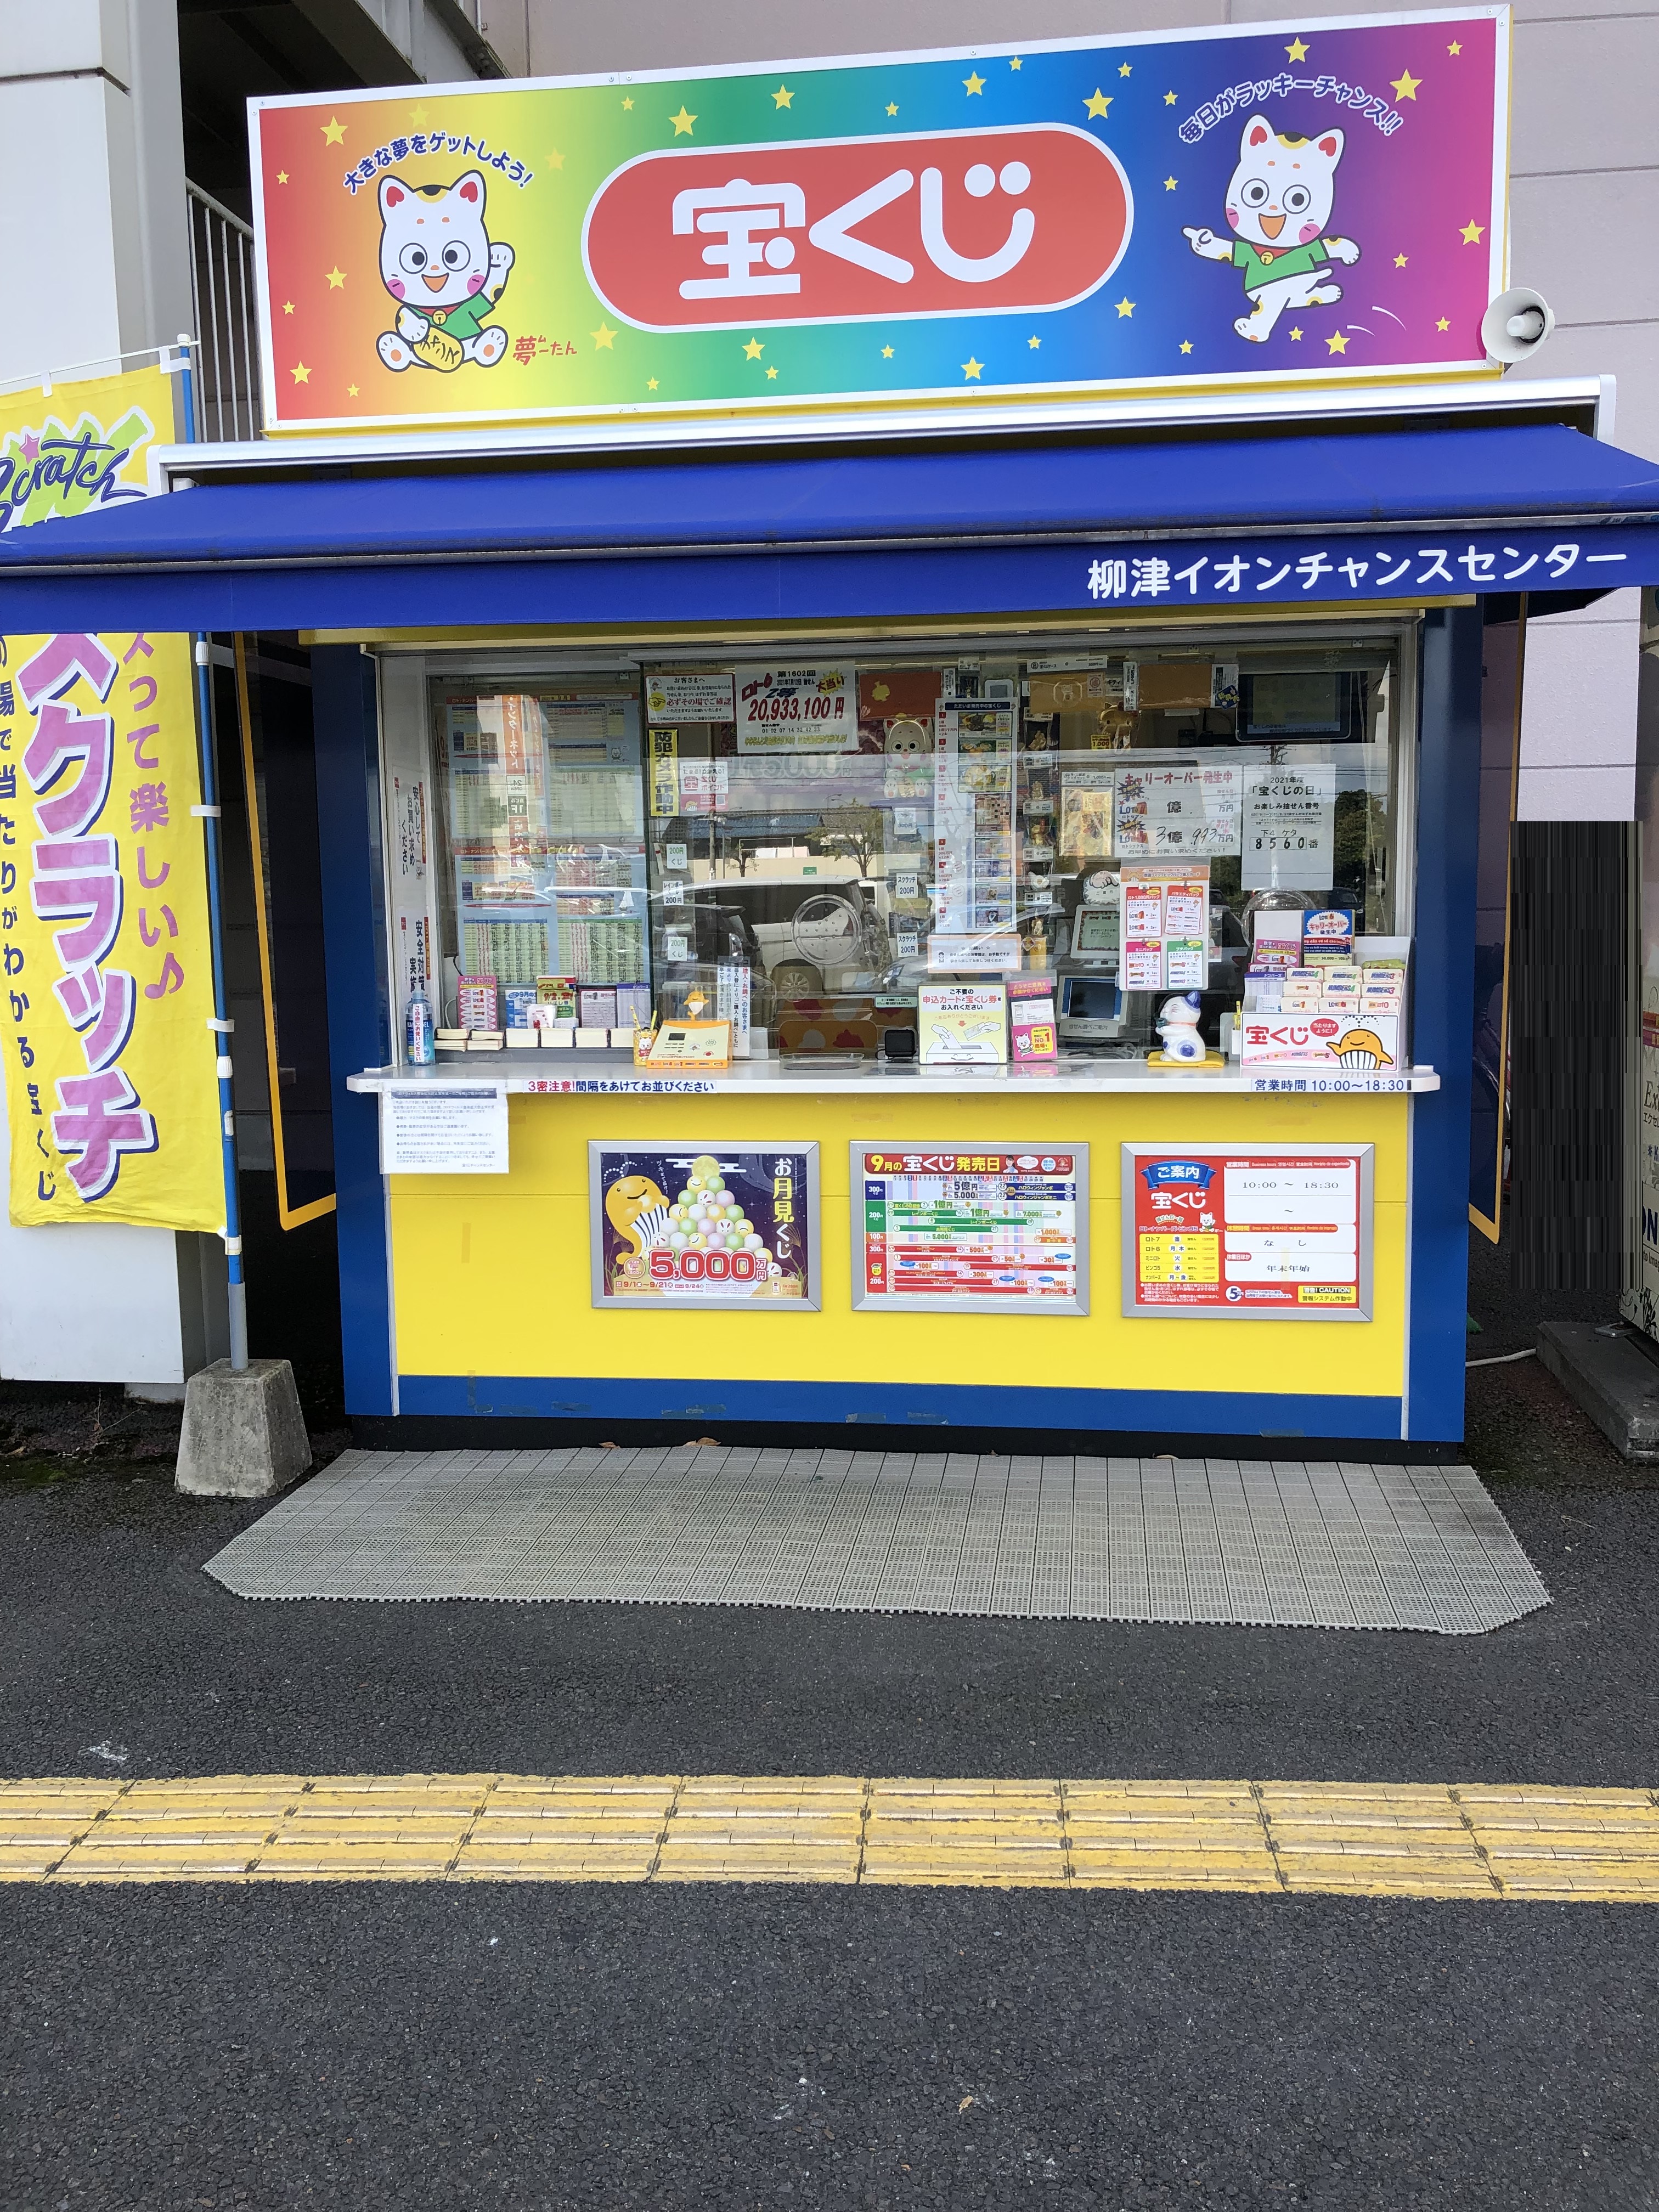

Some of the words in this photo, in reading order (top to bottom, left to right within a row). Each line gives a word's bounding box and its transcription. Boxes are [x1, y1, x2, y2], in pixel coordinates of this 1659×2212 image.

[673, 161, 1035, 300] 宝くじ
[1087, 544, 1627, 599] 柳津イオンチャンスセンター
[667, 697, 731, 706] 必ずその場でご確認
[654, 731, 674, 814] 防犯カメラ作動中
[1125, 770, 1233, 785] キャリーオーバー発生中
[1252, 786, 1322, 795] 「宝くじの日」
[1167, 801, 1182, 814] 億
[1218, 804, 1234, 812] 万円
[1155, 826, 1166, 845] 3
[1167, 831, 1182, 843] 億
[1217, 834, 1233, 843] 万円
[1308, 839, 1319, 849] 番
[898, 876, 916, 884] スクラッチ
[899, 886, 915, 895] 200円
[1308, 921, 1348, 931] キャリーオーバー
[900, 945, 915, 953] 200円
[922, 995, 1002, 1004] 申込カードと宝くじ券を
[1246, 1025, 1309, 1046] 宝くじ
[528, 1080, 714, 1092] 3密注意!間隔をあけてお並びください
[1255, 1079, 1306, 1091] 営業時間
[871, 1154, 1000, 1172] 9月の宝くじ発売日
[1157, 1165, 1200, 1179] ご案内
[954, 1181, 978, 1191] 5億円
[1150, 1192, 1206, 1209] 宝くじ
[772, 1158, 795, 1259] お月見くじ
